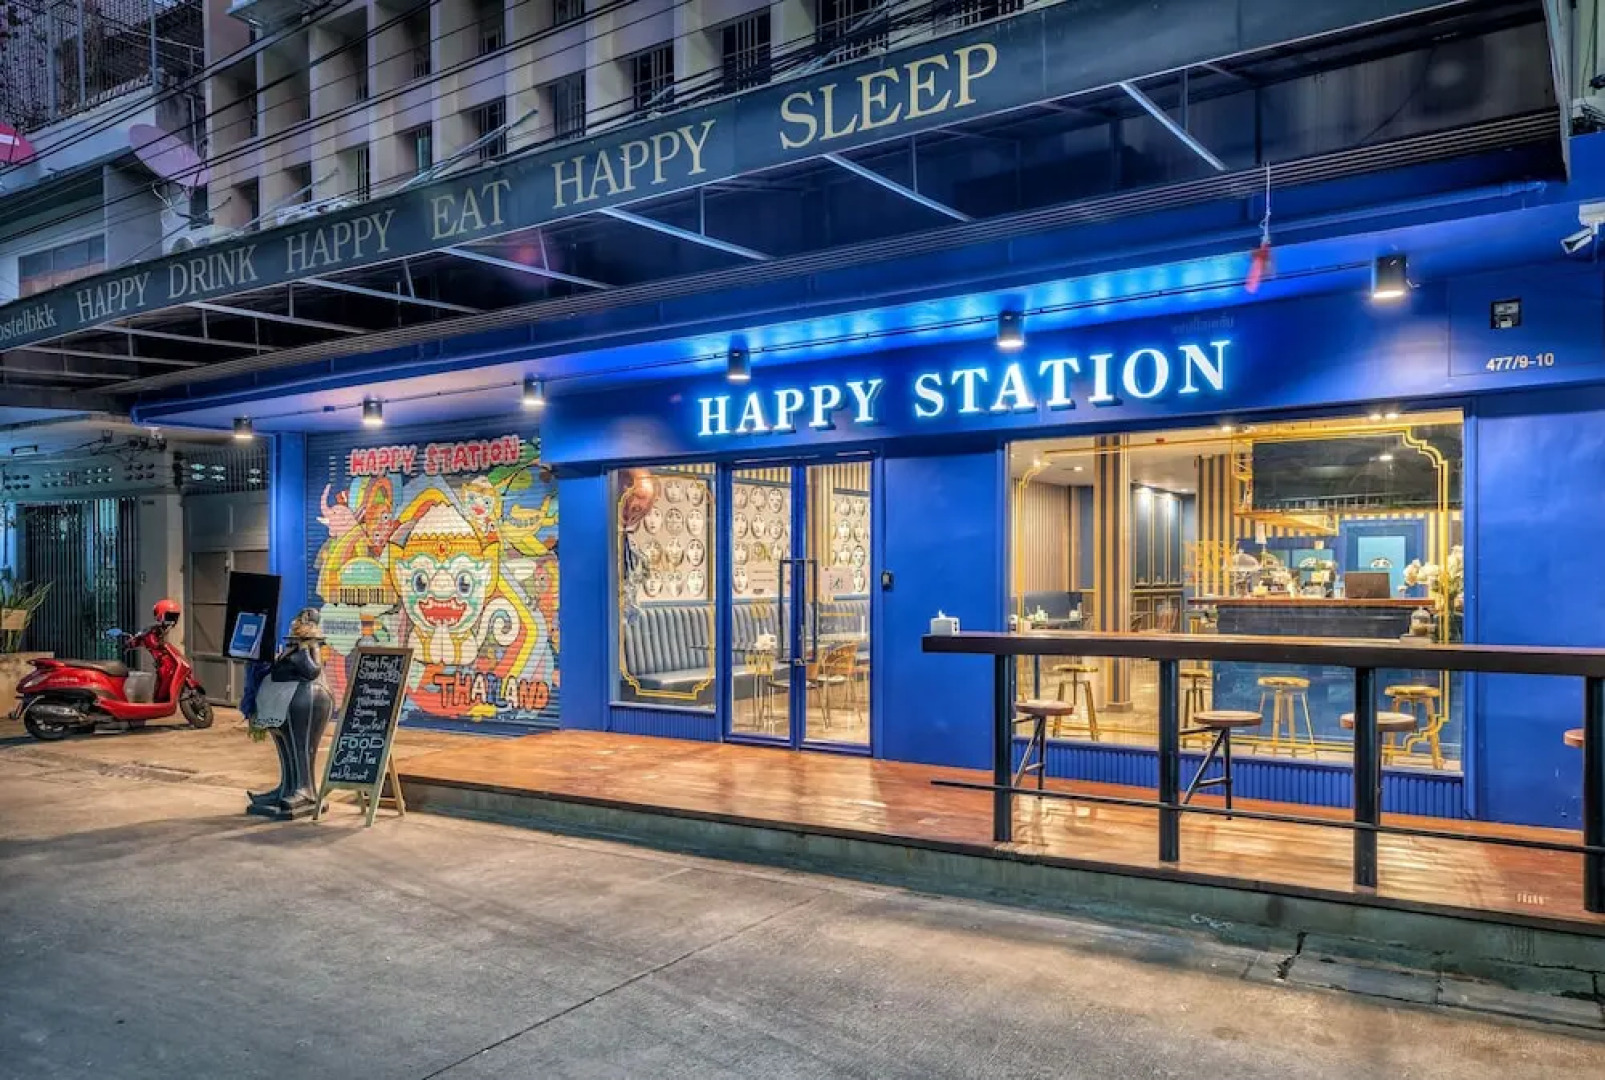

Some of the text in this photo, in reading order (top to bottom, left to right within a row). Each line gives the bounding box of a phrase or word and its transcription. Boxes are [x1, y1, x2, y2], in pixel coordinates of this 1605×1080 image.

[77, 272, 152, 323] HAPPY
[168, 245, 258, 298] DRINK
[285, 209, 396, 274] HAPPY
[430, 179, 511, 240] EAT
[552, 120, 716, 209] HAPPY
[779, 43, 998, 150] SLEEP
[1486, 352, 1555, 372] 477/9-10
[697, 339, 1231, 437] HAPPY STATION
[350, 434, 521, 476] HAPPY STATION
[433, 670, 550, 711] THAILAND
[339, 736, 385, 750] FOOD
